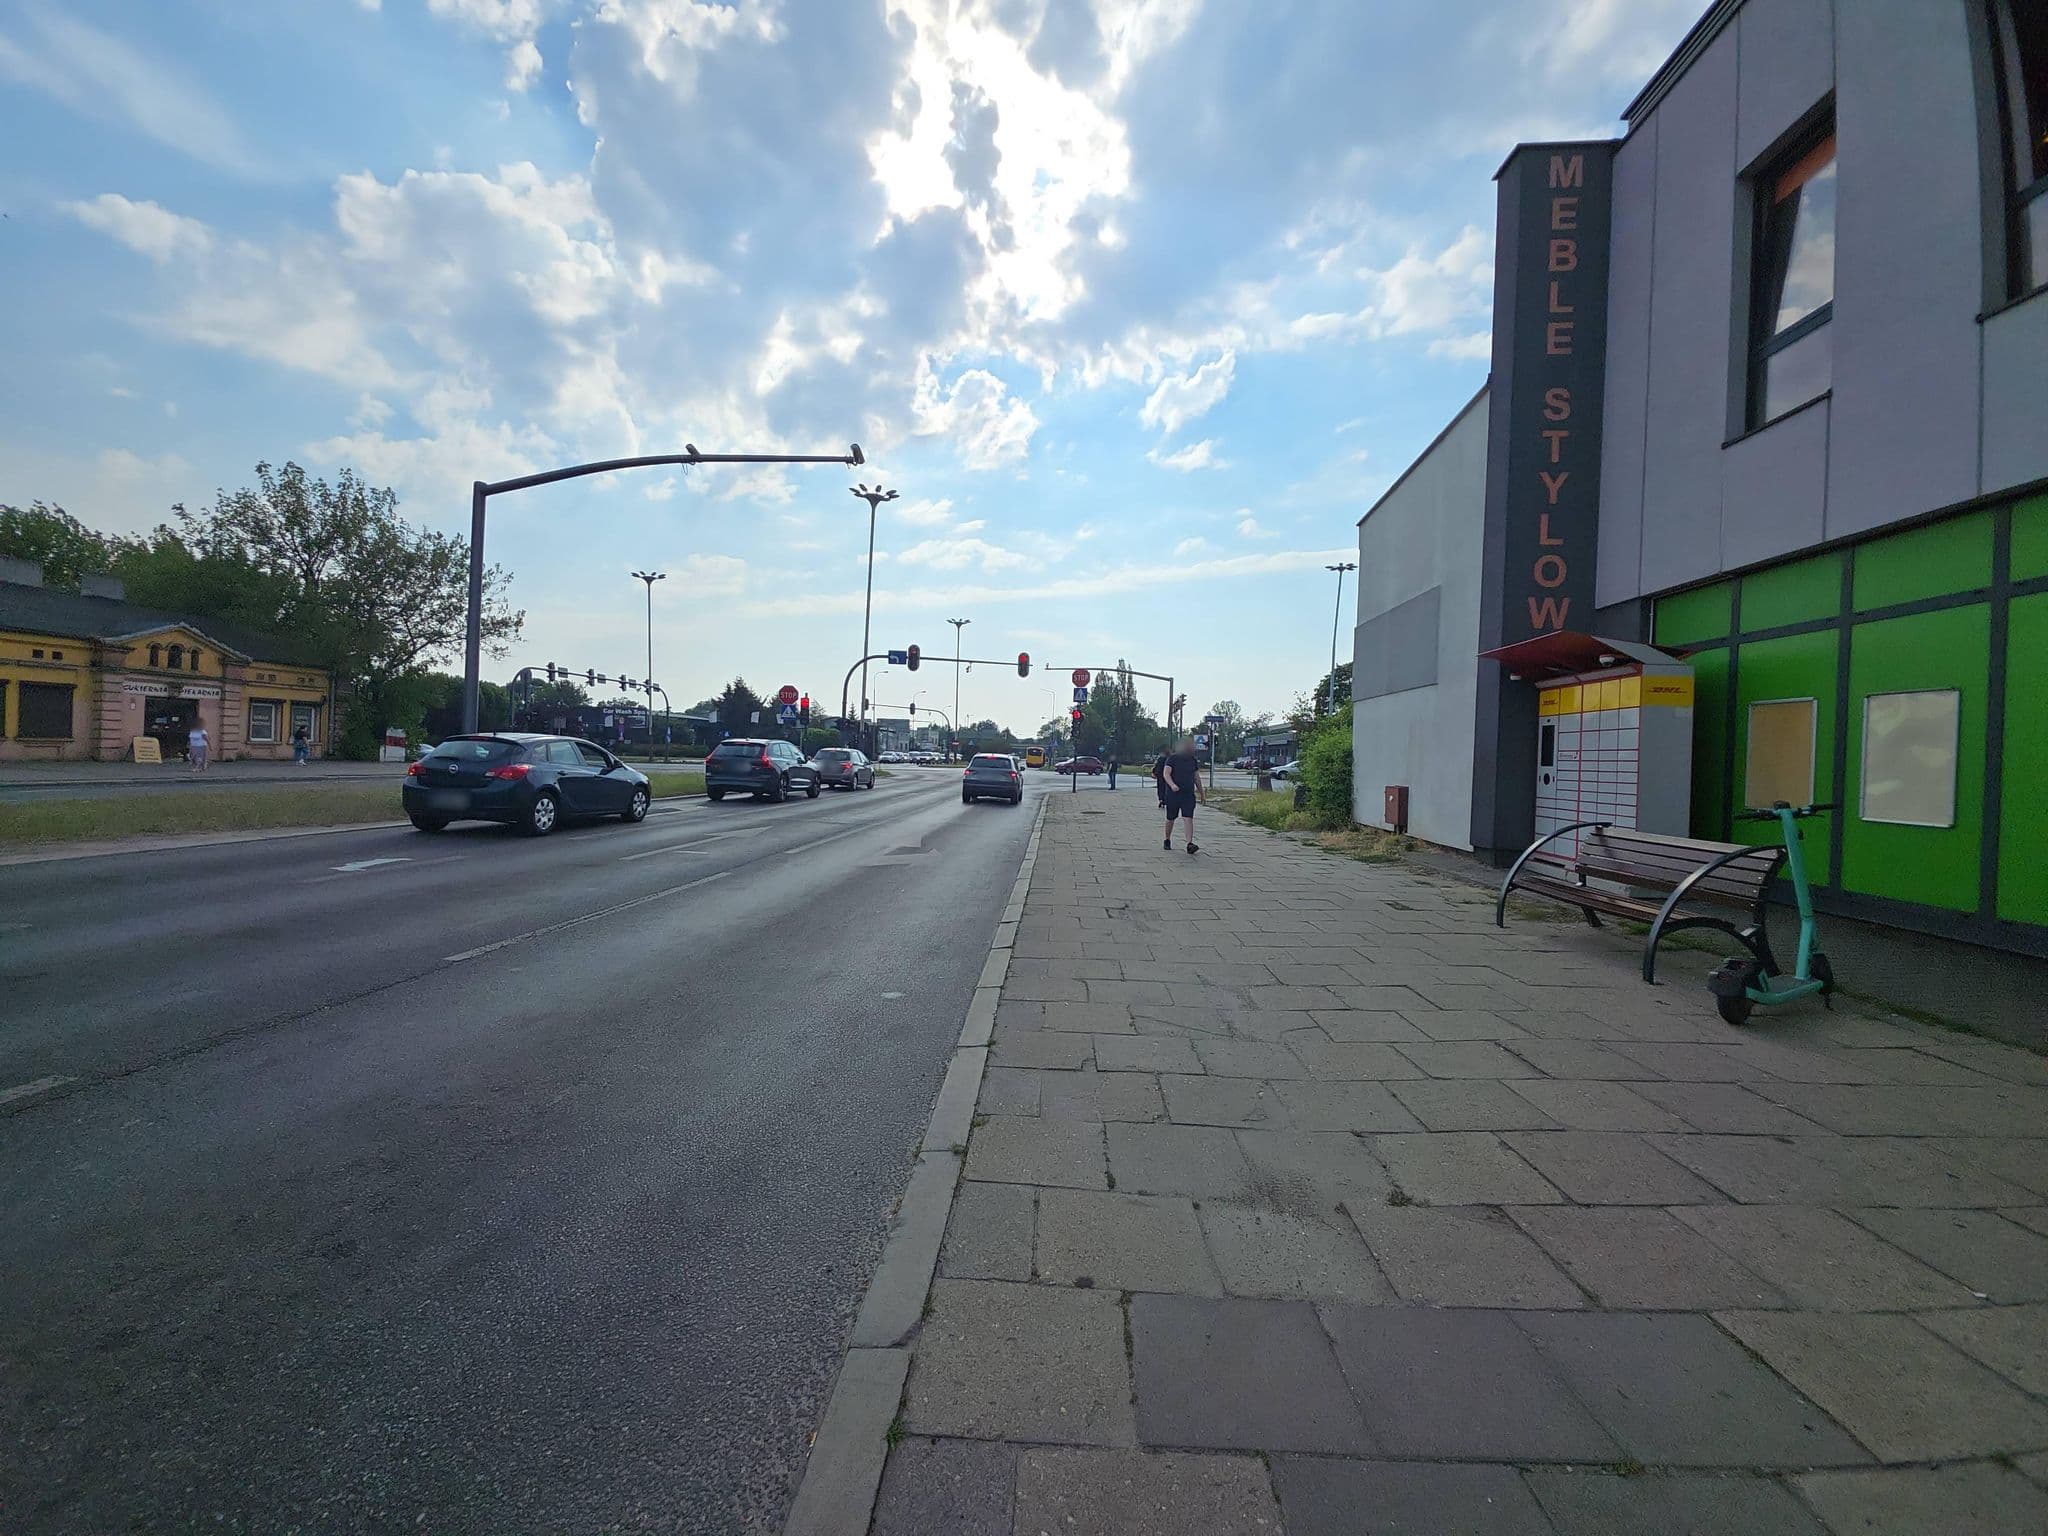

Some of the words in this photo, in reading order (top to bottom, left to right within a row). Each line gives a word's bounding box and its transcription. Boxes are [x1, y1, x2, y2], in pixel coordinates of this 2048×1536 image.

[1546, 155, 1583, 355] MEBLE
[1528, 388, 1571, 630] STYLOW
[780, 691, 797, 699] STOP
